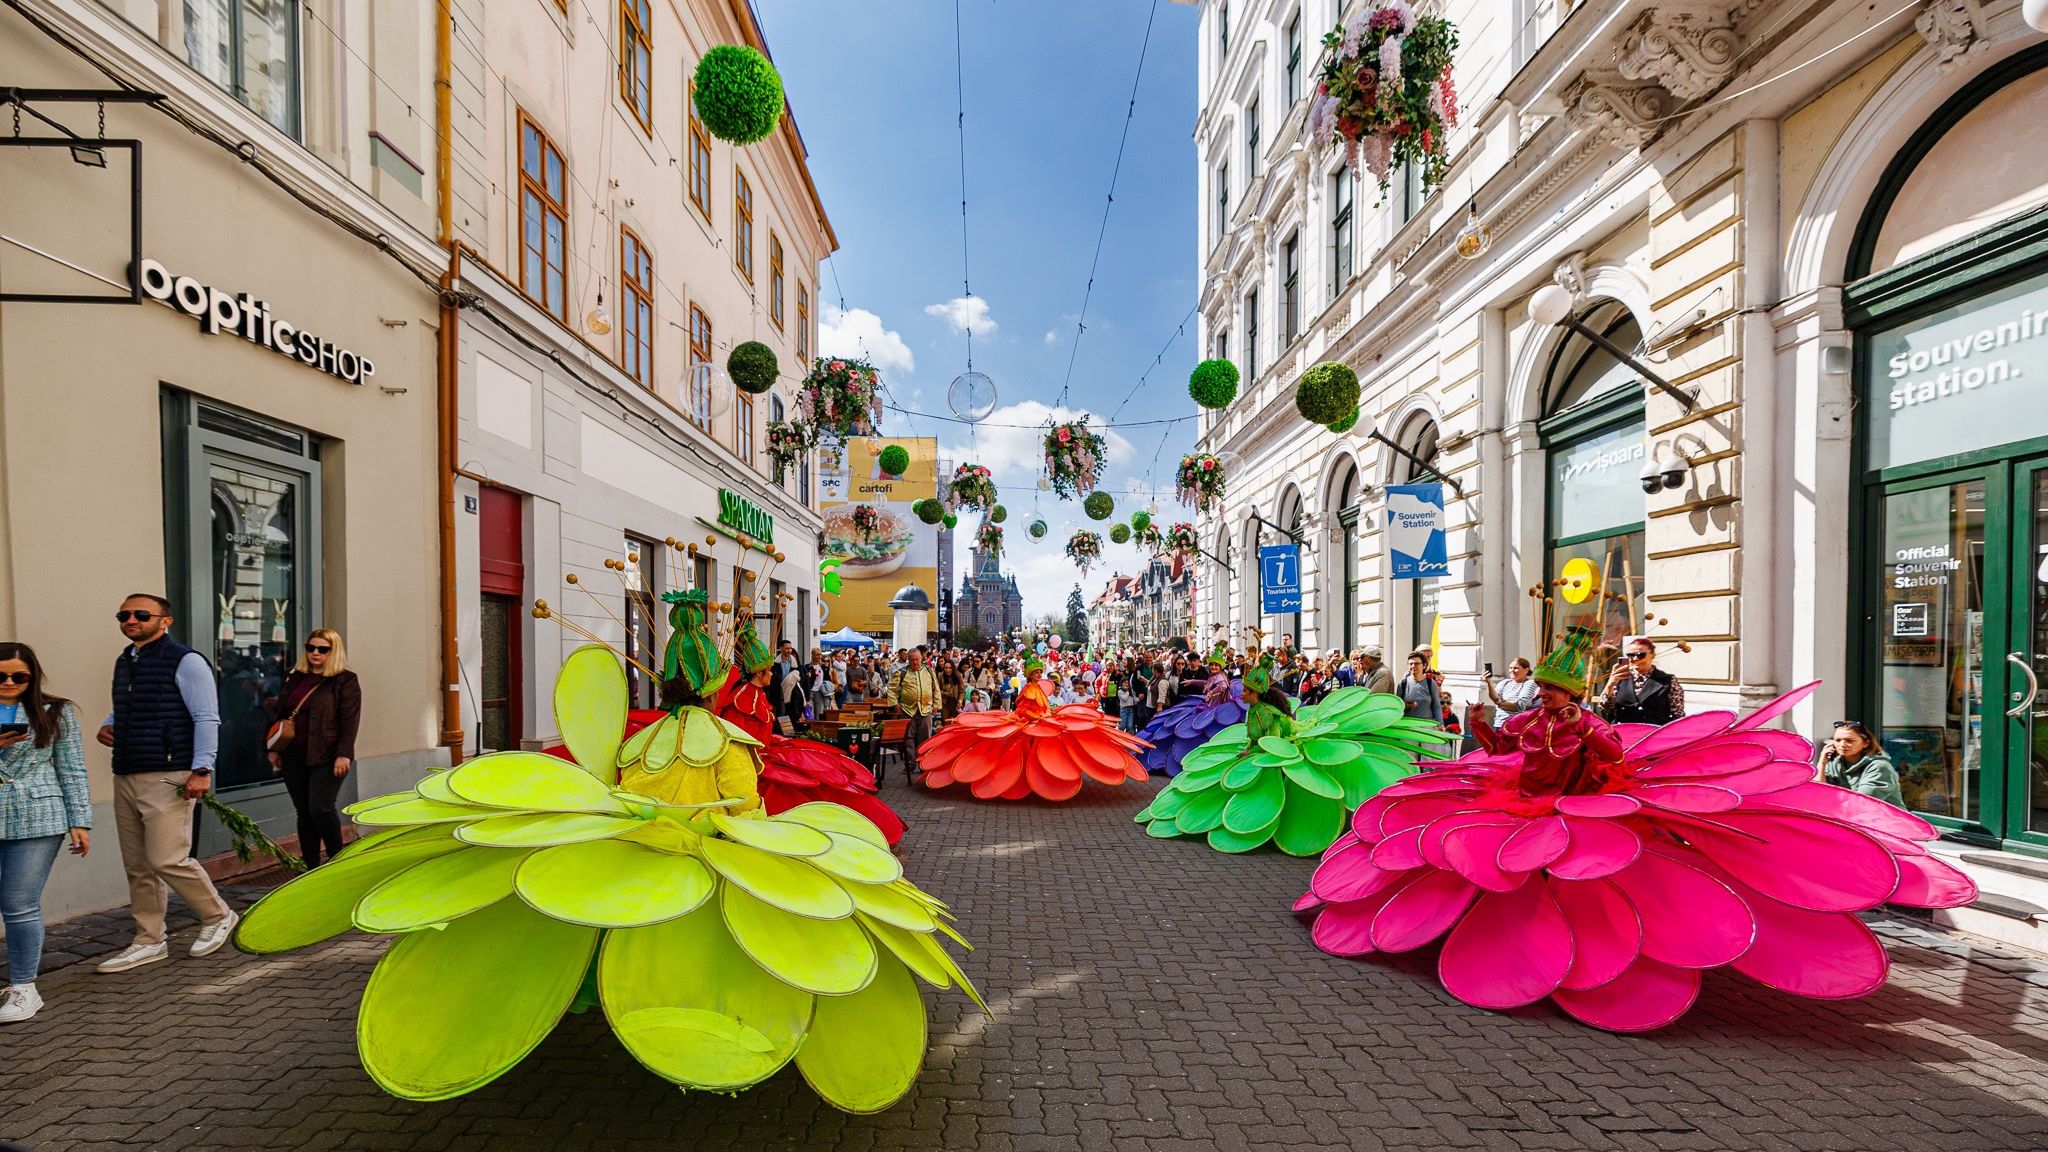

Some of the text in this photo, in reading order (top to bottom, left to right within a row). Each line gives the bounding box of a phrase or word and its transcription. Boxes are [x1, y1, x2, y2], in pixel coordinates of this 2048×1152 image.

[1888, 308, 2048, 378] Souvenir
[1889, 358, 2022, 410] station.
[858, 483, 893, 493] cartofi
[723, 489, 774, 543] SPARTAN
[1398, 510, 1437, 520] Souvenir
[1402, 520, 1435, 529] Station
[1896, 544, 1950, 560] Official
[1895, 558, 1961, 574] Souvenir
[1895, 574, 1948, 588] Station
